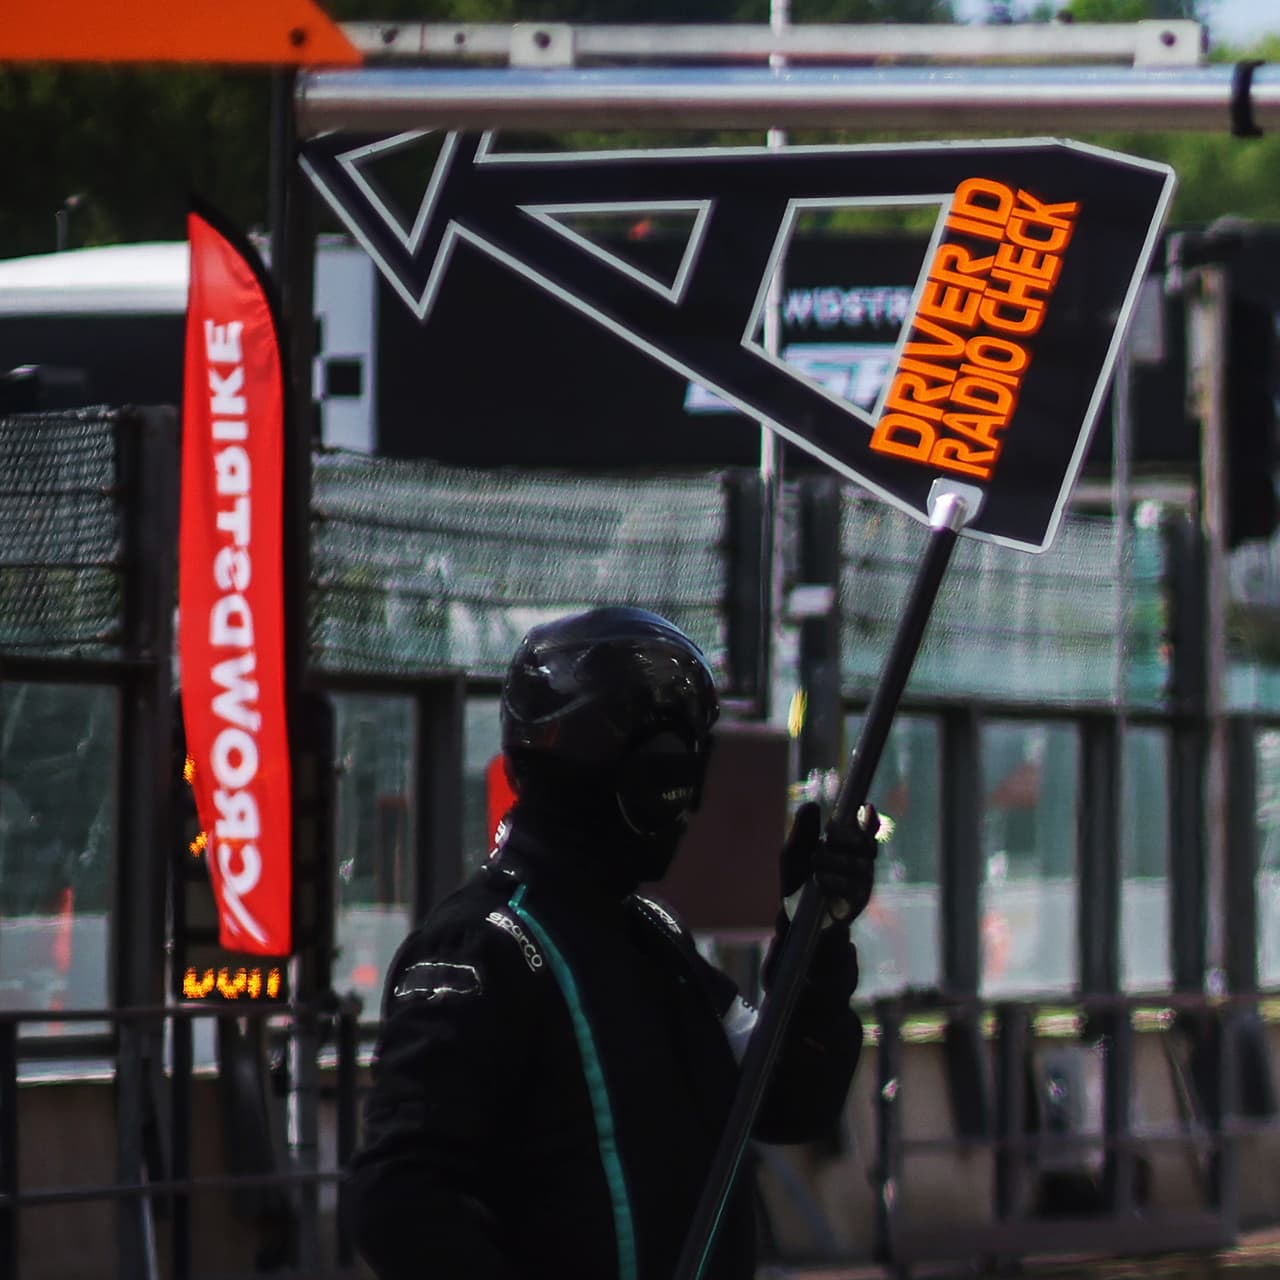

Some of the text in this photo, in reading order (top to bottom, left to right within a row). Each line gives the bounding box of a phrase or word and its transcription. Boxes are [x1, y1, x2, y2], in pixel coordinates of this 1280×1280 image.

[869, 176, 1015, 463] DRIVER ID
[928, 189, 1079, 478] RADIO CHECK
[486, 911, 543, 969] sparco
